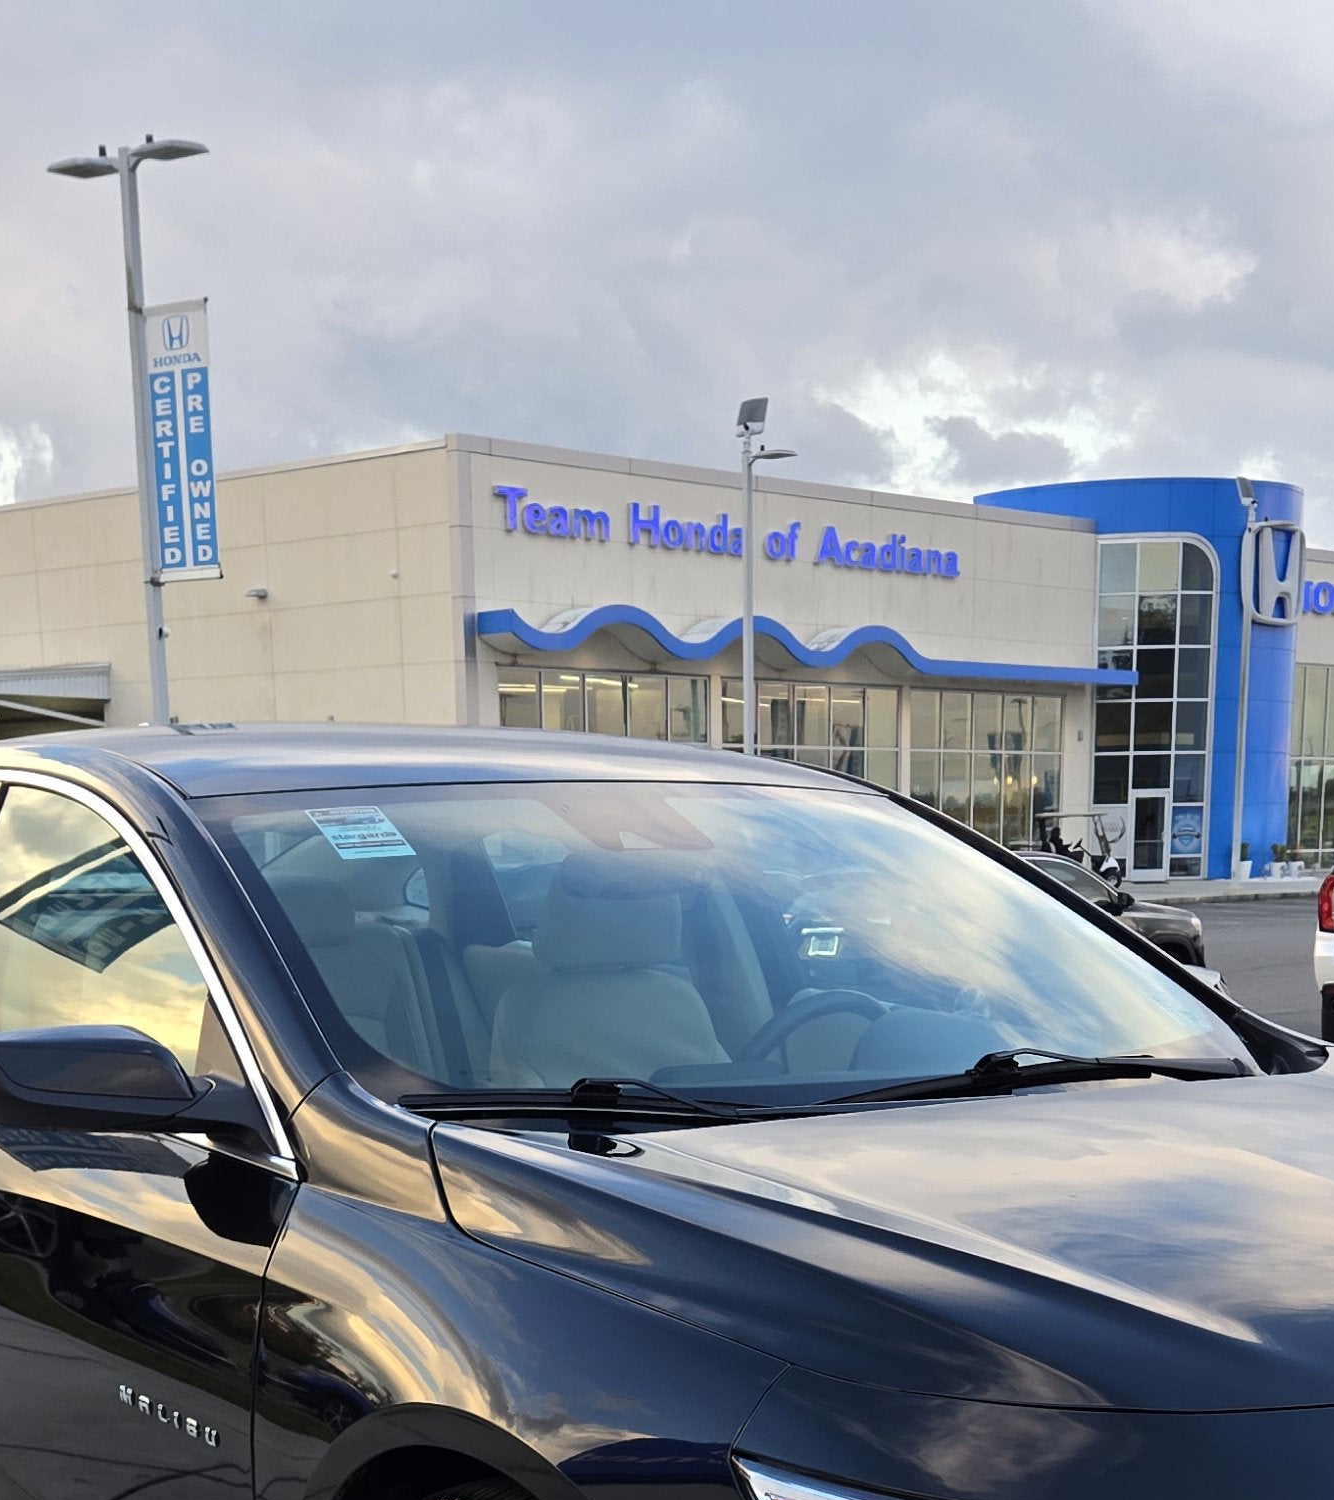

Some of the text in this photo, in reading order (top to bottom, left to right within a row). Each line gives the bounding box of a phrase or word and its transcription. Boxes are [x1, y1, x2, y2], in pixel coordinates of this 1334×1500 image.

[152, 352, 201, 368] HONDA
[153, 376, 182, 564] CERTIFIED
[186, 372, 213, 562] PRE OWNED
[492, 485, 960, 578] Team Honda of Acadiana
[119, 1384, 217, 1447] MALIBU
